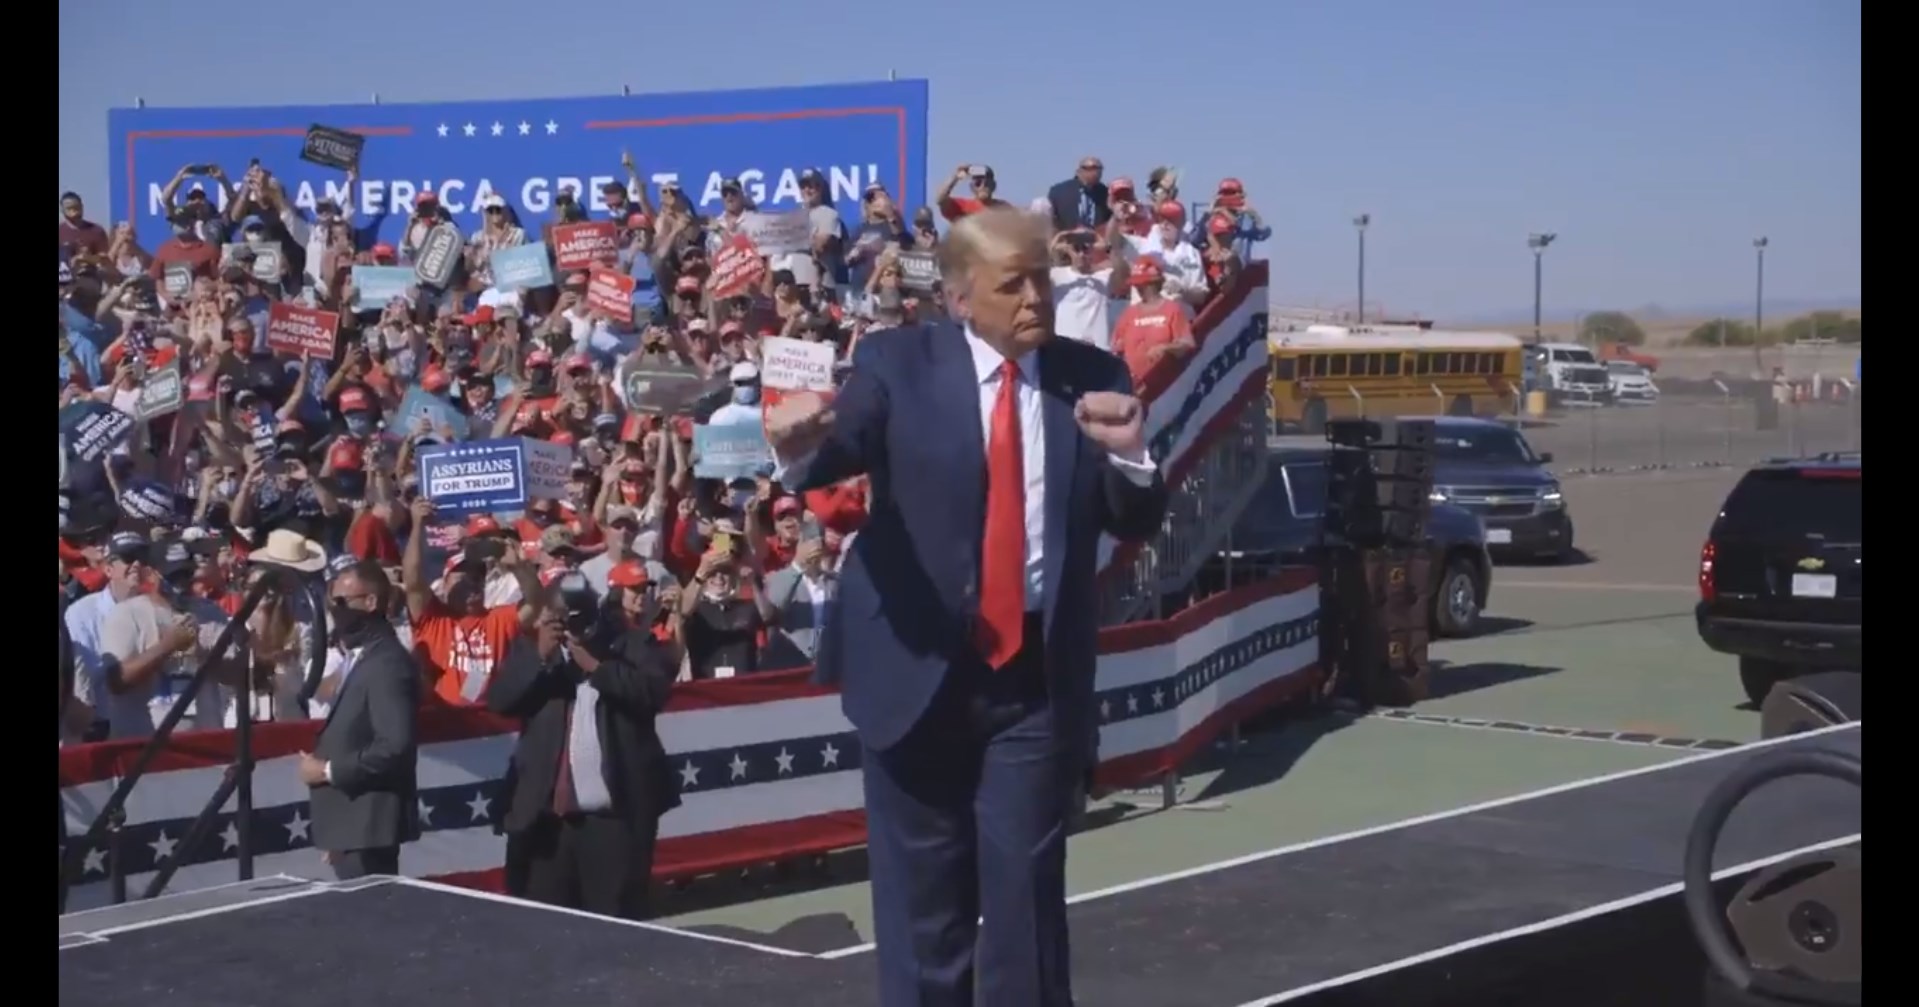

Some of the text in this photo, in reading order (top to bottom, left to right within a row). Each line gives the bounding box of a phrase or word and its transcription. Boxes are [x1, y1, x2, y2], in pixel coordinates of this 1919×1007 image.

[268, 318, 333, 342] AMERICA
[767, 356, 826, 374] AMERICA
[72, 411, 125, 456] AMERICA
[431, 458, 513, 479] ASSYRIANS
[434, 480, 461, 494] FOR
[465, 476, 512, 491] TRUMP
